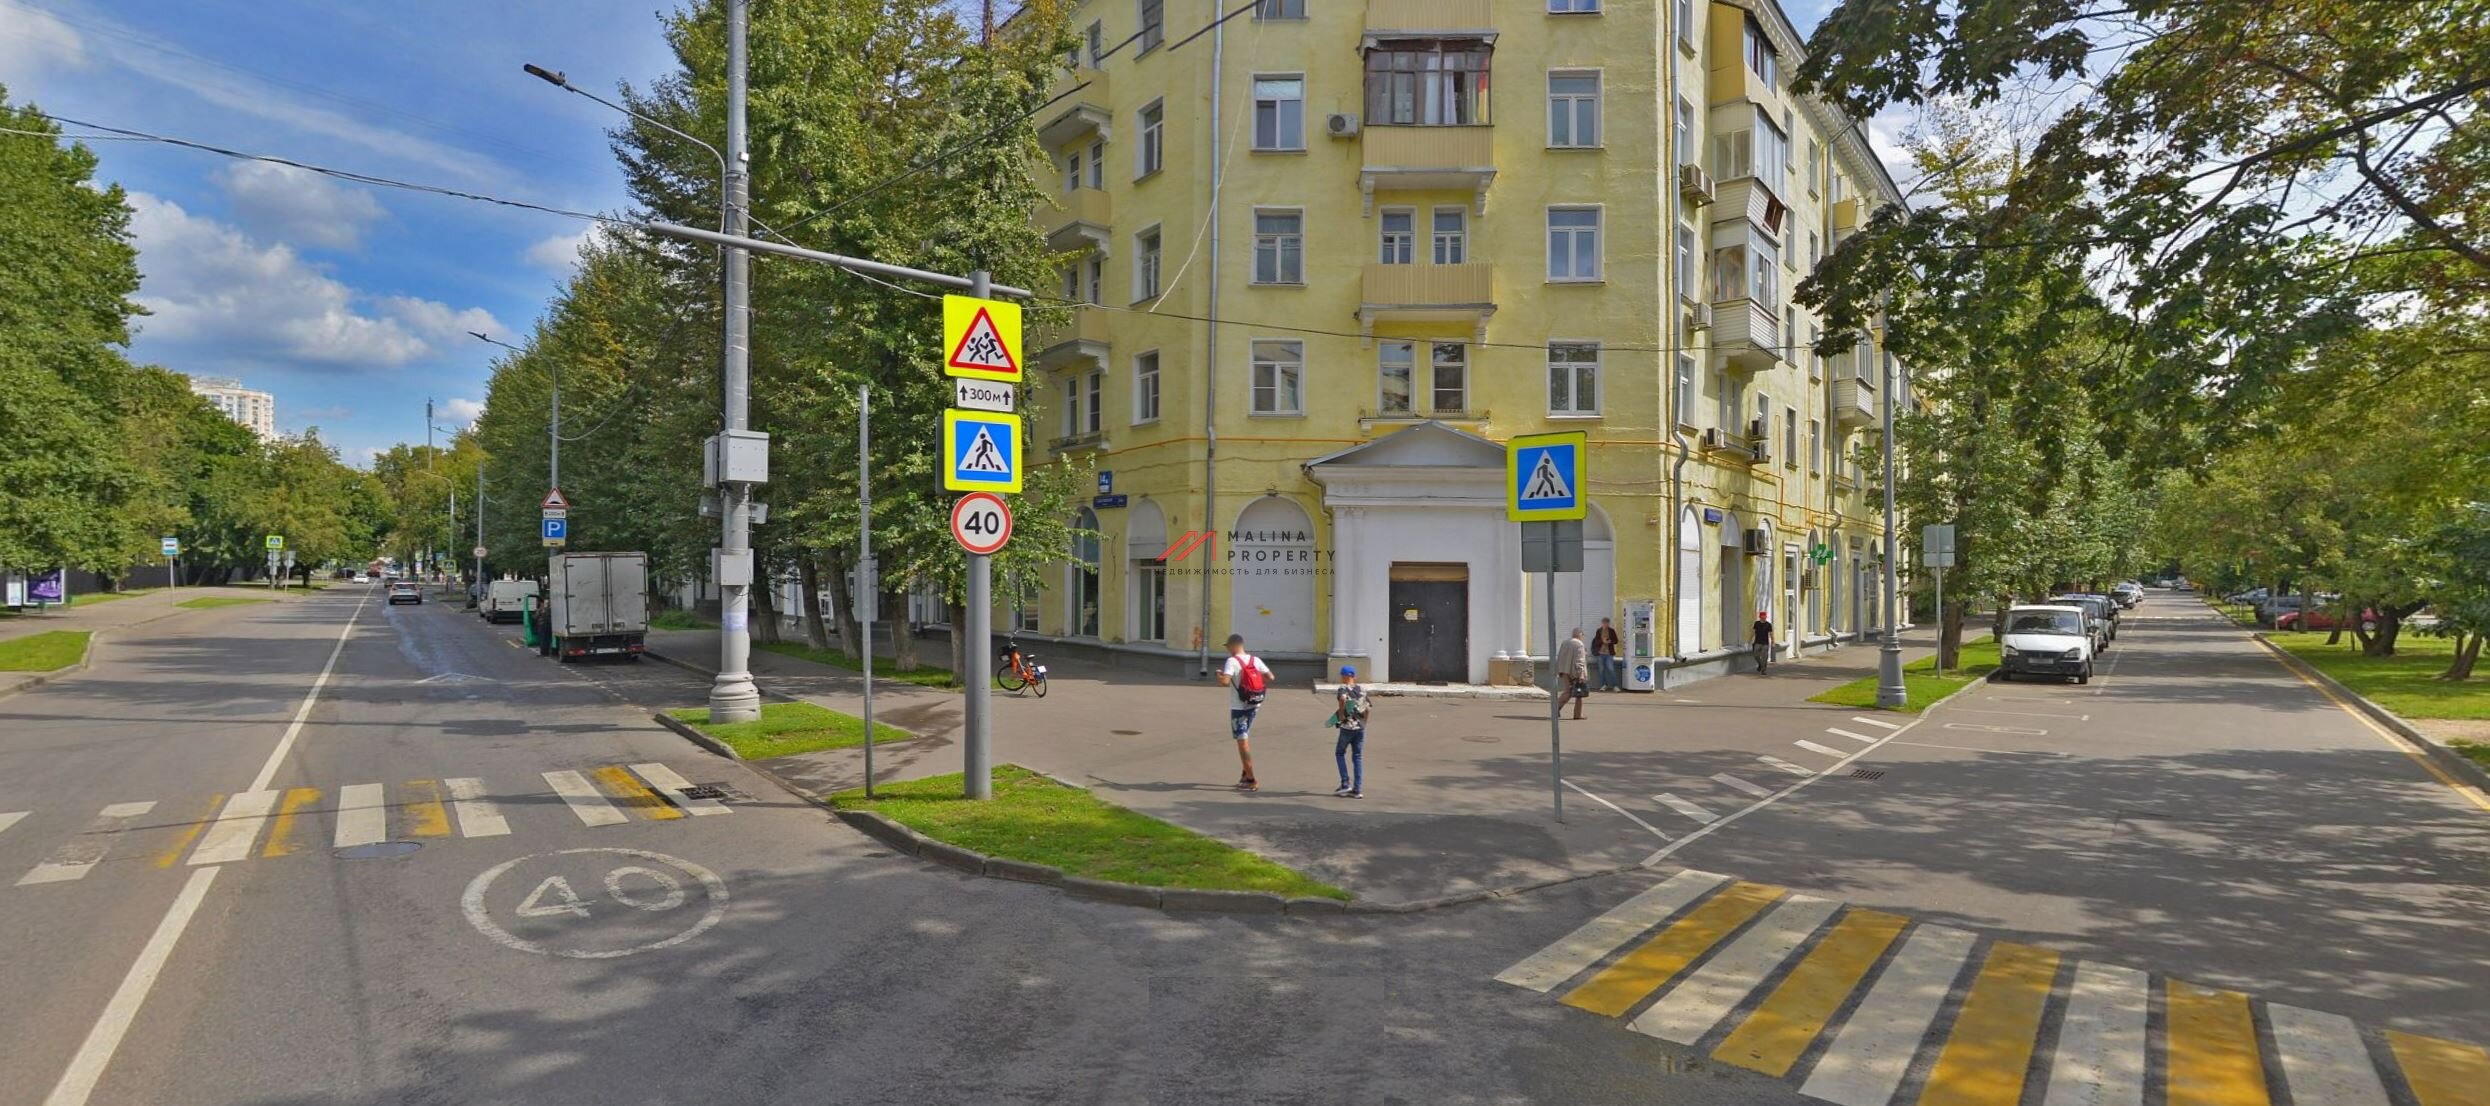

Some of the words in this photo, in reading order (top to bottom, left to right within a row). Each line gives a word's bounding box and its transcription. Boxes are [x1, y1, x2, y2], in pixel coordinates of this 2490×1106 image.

[548, 521, 561, 537] P
[964, 511, 999, 535] 40
[515, 866, 685, 918] 40
